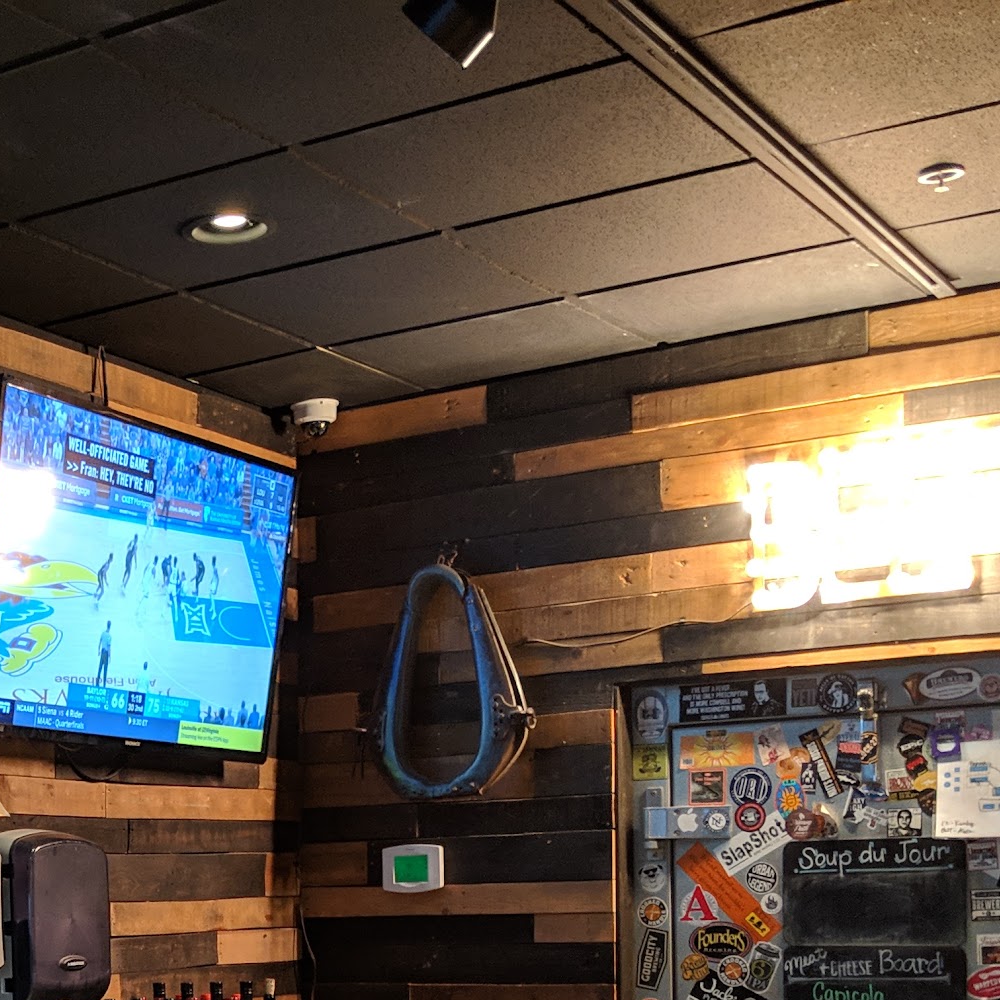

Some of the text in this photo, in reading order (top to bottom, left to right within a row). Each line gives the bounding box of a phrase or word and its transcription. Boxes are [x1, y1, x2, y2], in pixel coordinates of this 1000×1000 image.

[69, 436, 150, 473] WELL-OFFICIATED GAME.
[80, 461, 98, 478] Fran:
[99, 467, 115, 485] HEY,
[116, 471, 144, 491] THEY'RE
[144, 480, 154, 494] NO
[111, 692, 125, 709] 66
[148, 698, 159, 714] 75
[799, 839, 950, 878] Soup du Jour
[680, 885, 718, 921] A
[641, 935, 658, 982] GOODCITY
